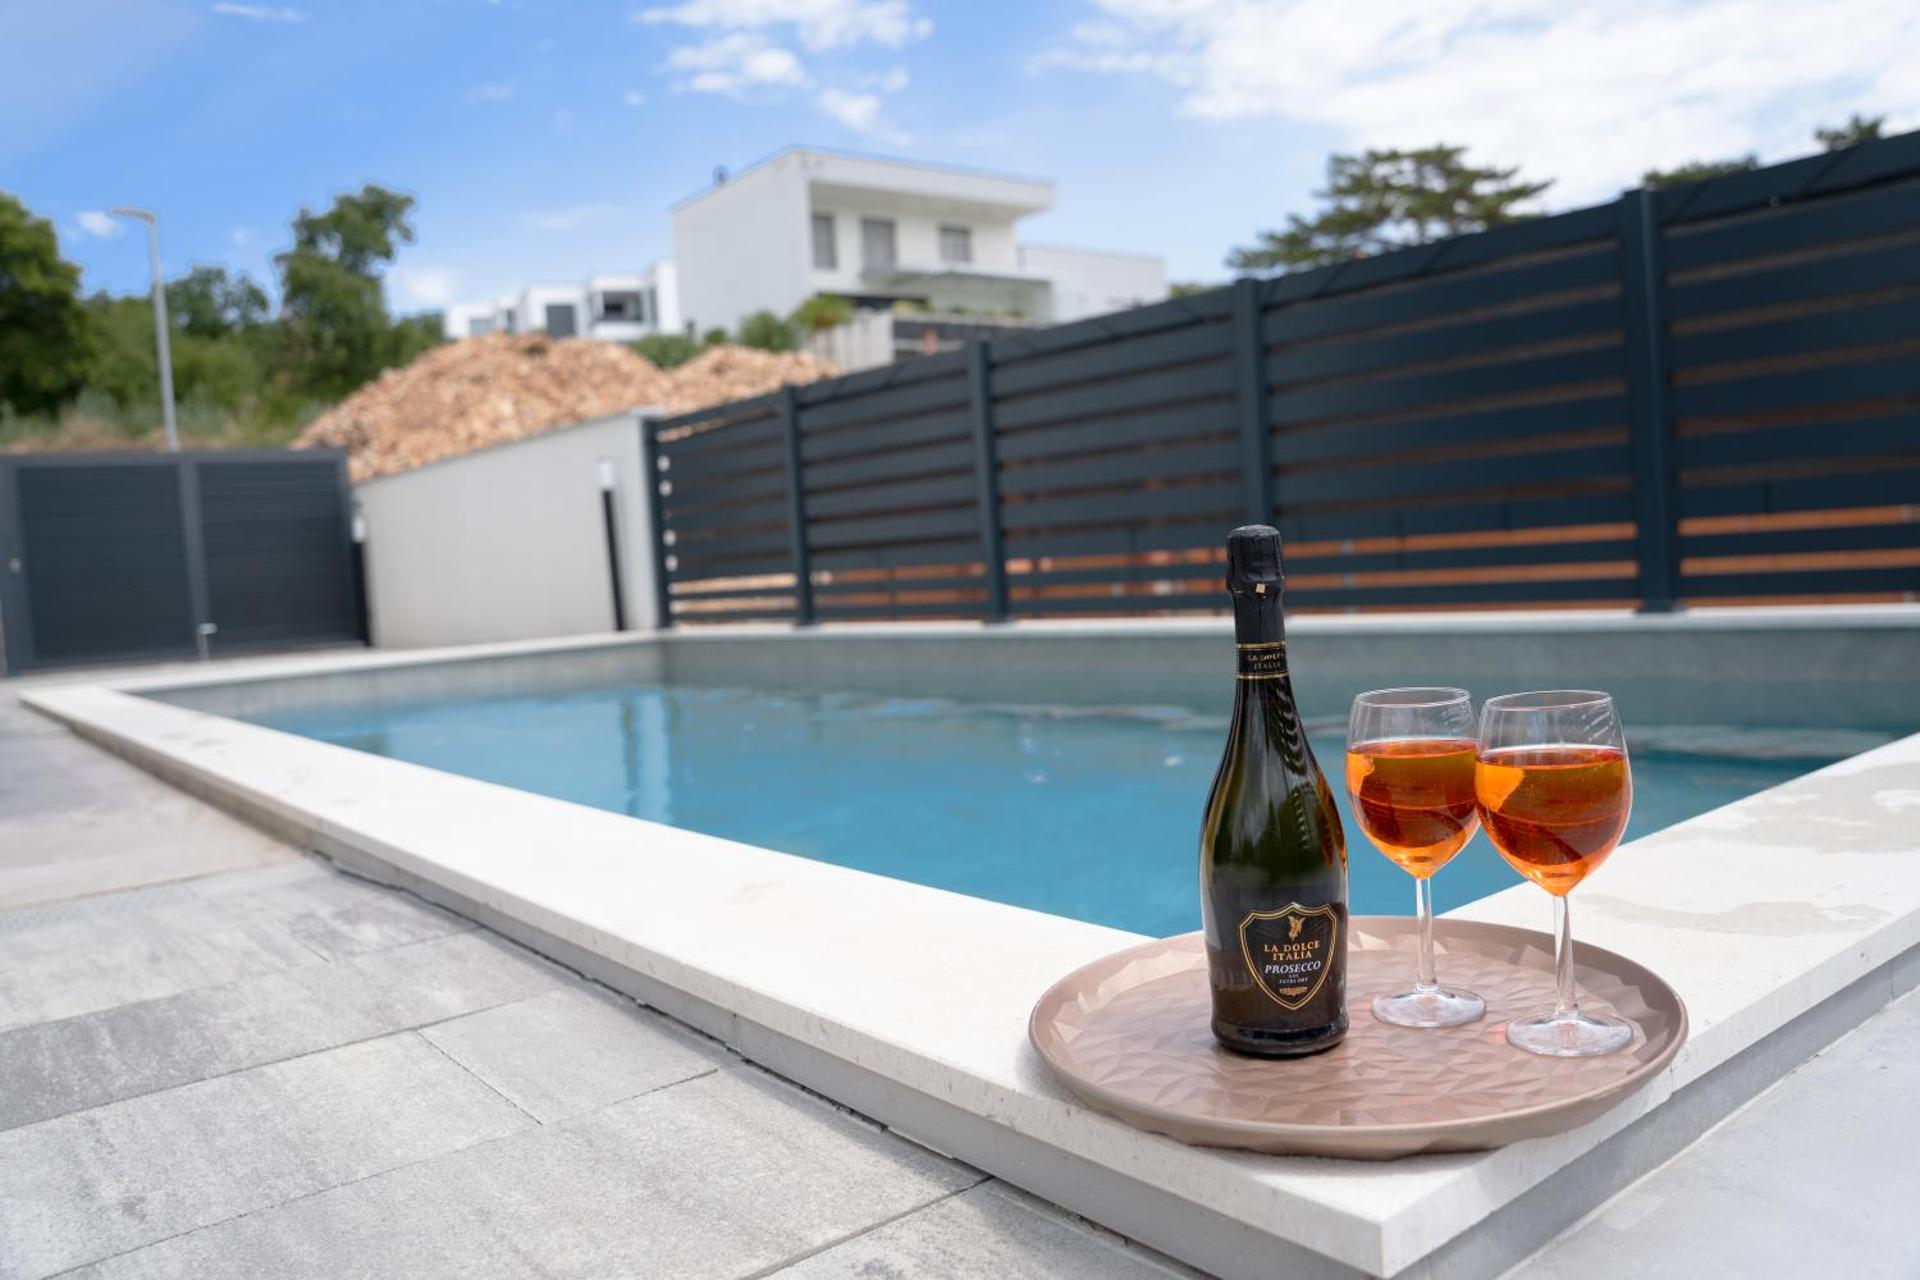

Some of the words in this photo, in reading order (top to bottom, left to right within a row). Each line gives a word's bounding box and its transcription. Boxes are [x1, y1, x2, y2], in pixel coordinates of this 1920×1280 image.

[1264, 944, 1279, 952] LA
[1284, 940, 1320, 952] DOLCE
[1273, 951, 1312, 960] ITALIA
[1264, 960, 1321, 974] PROSECCO
